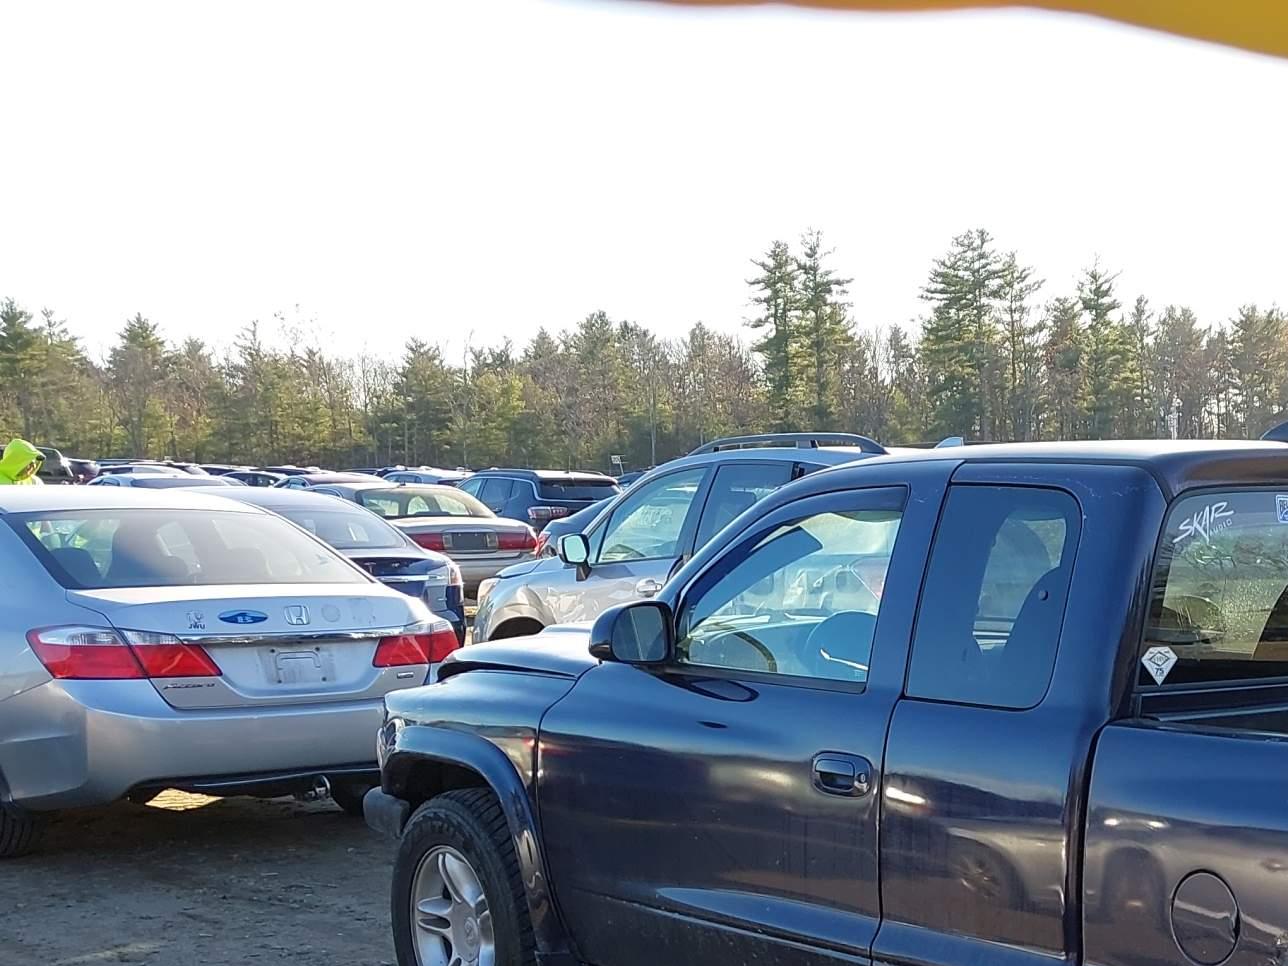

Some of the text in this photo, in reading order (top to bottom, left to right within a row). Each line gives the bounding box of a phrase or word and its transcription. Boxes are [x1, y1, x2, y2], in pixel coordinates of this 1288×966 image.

[1173, 502, 1234, 546] SKAR
[1210, 519, 1233, 536] AUDIO
[1154, 667, 1165, 675] 75
